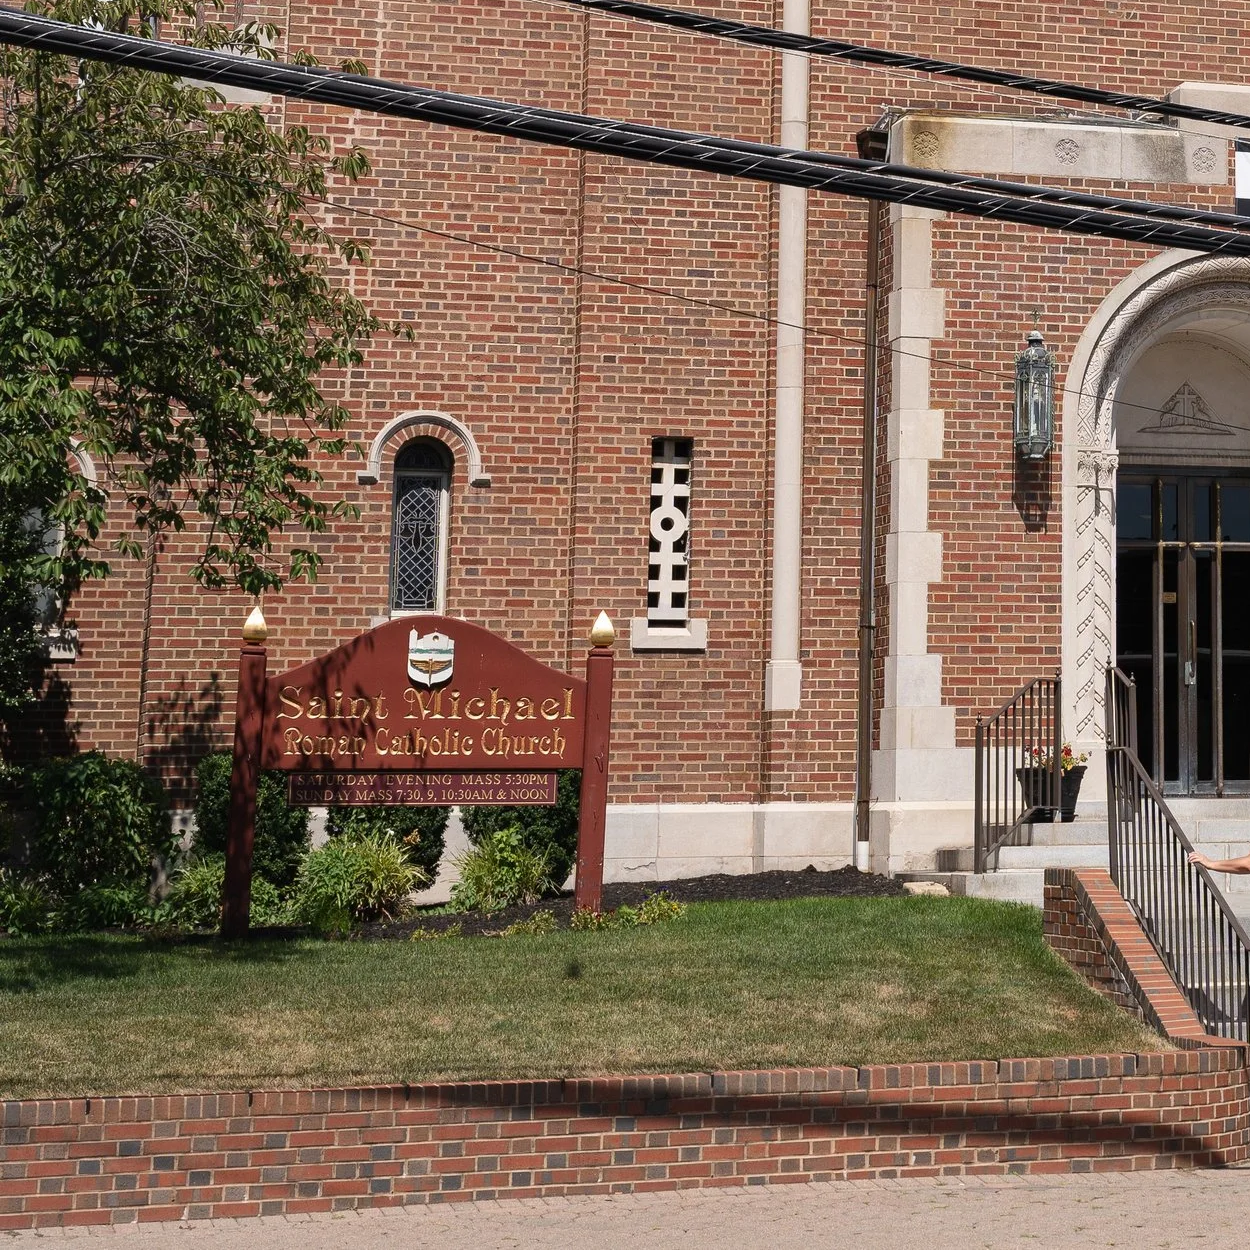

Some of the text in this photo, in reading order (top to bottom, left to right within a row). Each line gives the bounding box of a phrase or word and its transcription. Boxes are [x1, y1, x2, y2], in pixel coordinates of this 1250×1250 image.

[276, 686, 575, 726] Saint Michael
[283, 727, 567, 760] Roman Catholic Church
[297, 774, 548, 786] SATURDAY EVENING MASS 5:30PM
[295, 788, 549, 802] SUNDAY MASS 7:30, 9, 10:30AM & NOON
